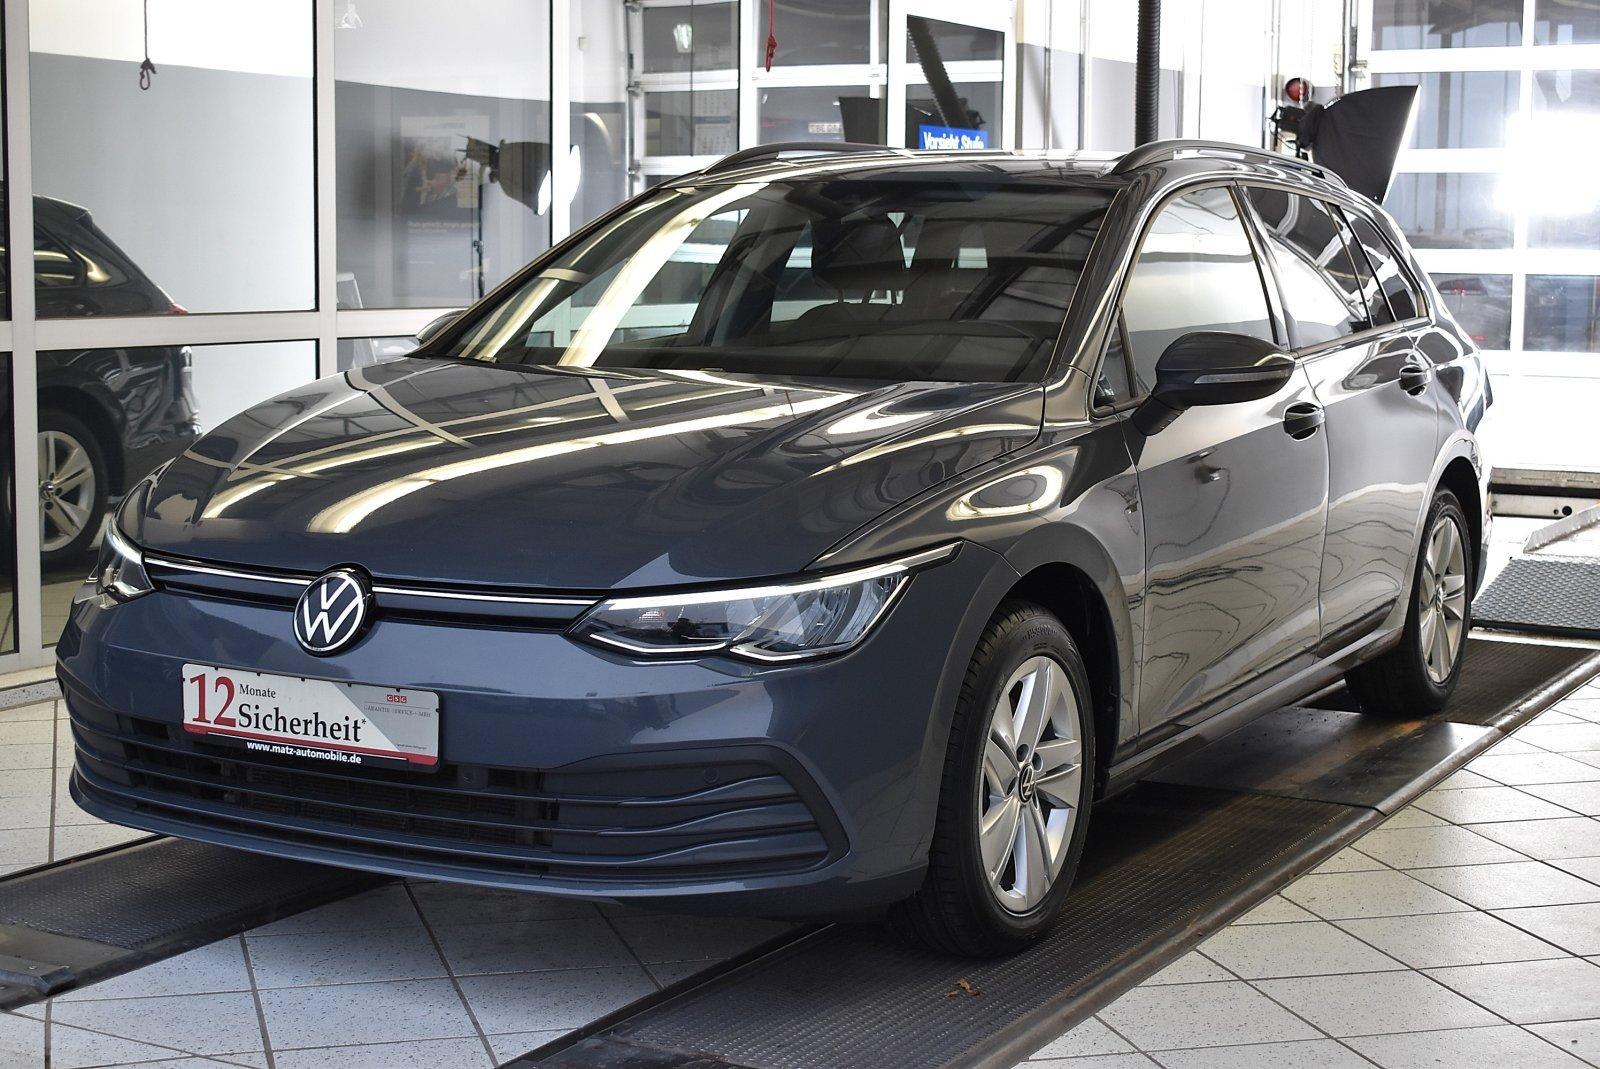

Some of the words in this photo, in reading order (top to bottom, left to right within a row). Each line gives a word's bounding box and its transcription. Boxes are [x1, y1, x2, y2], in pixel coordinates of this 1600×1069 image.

[298, 572, 364, 648] VW
[190, 673, 237, 728] 12
[239, 683, 277, 699] Monate
[246, 741, 362, 764] www.matz-automobile.de
